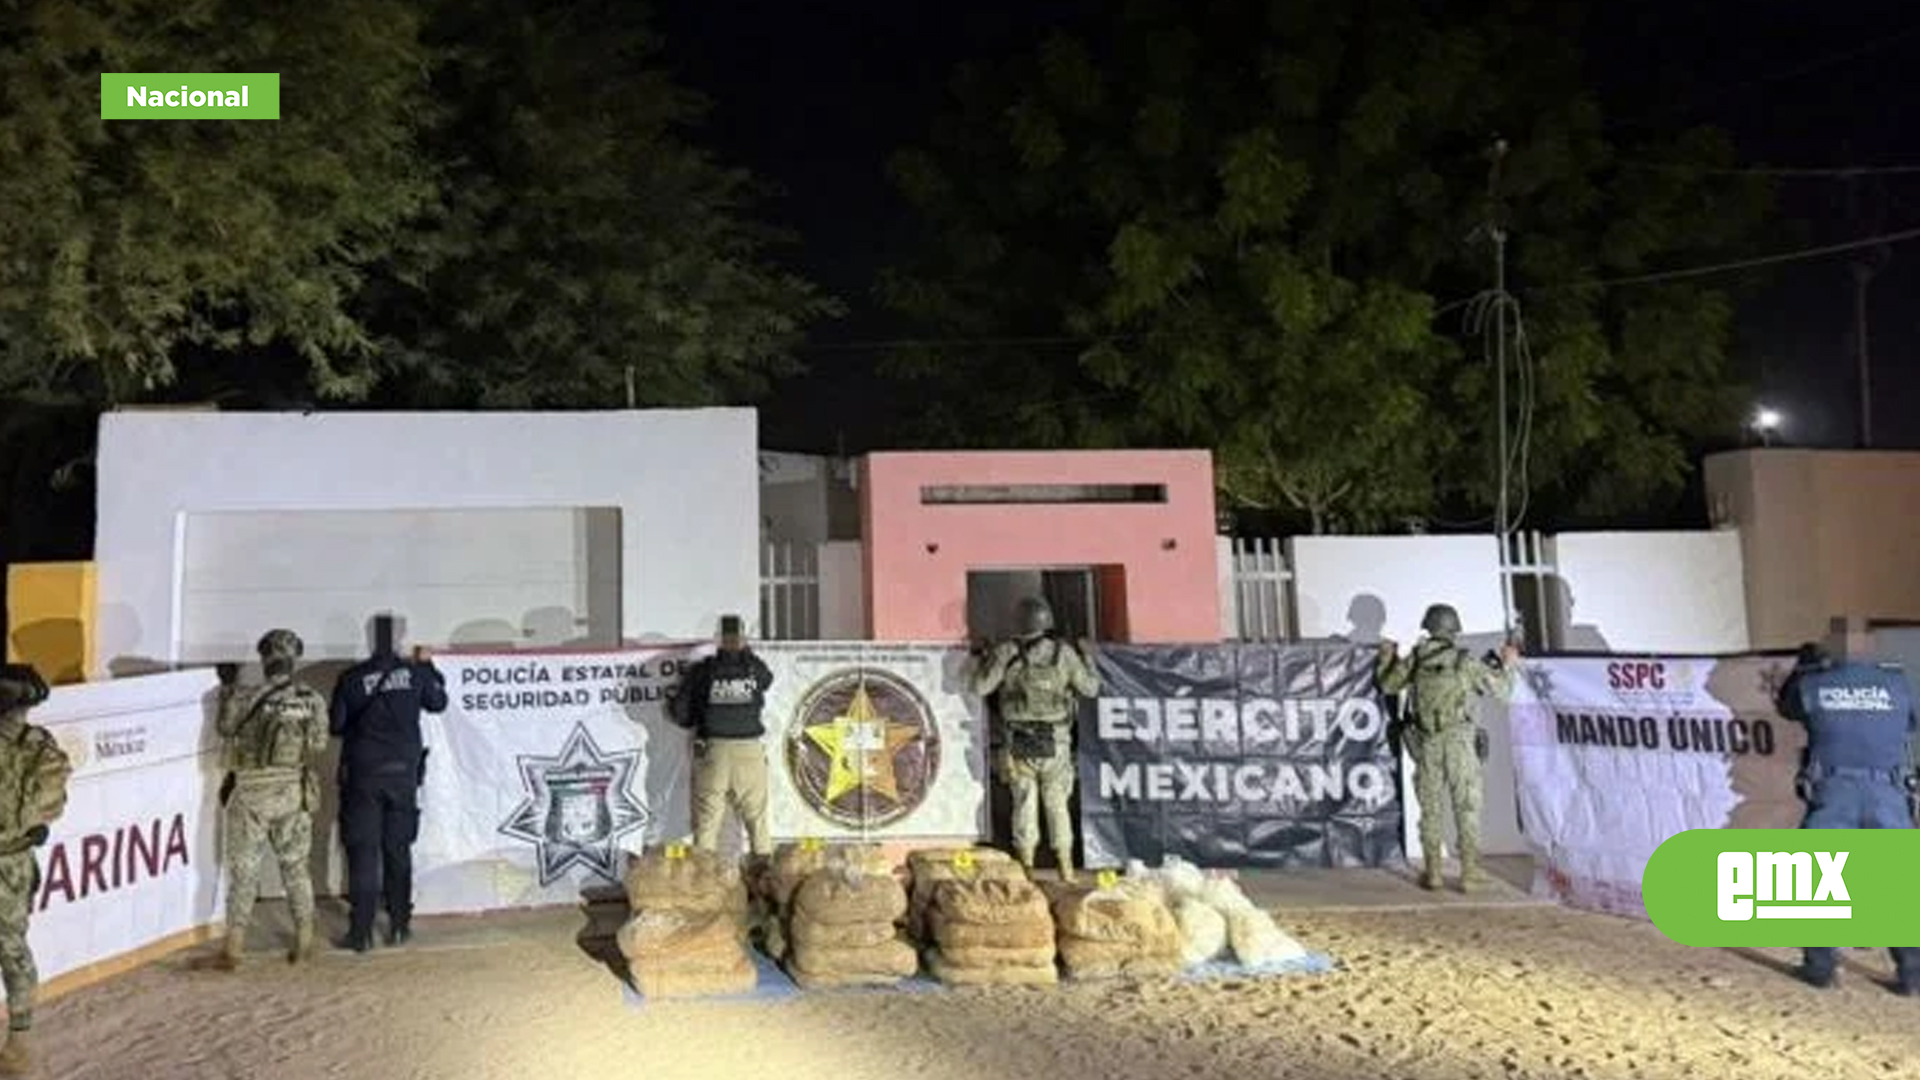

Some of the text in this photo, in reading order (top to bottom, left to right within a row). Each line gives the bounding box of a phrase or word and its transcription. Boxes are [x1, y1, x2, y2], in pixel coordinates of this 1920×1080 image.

[461, 660, 690, 685] POLICÍA ESTATAL DE
[1607, 662, 1665, 690] SSPC
[462, 688, 589, 711] SEGURIDAD
[600, 681, 681, 704] PÚBLIC
[1818, 685, 1891, 700] POLICÍA
[1097, 686, 1381, 742] EJÉRCITO
[1556, 711, 1774, 756] MANDO ÚNICO
[1100, 760, 1387, 803] MEXICANO
[28, 812, 189, 914] ARINA
